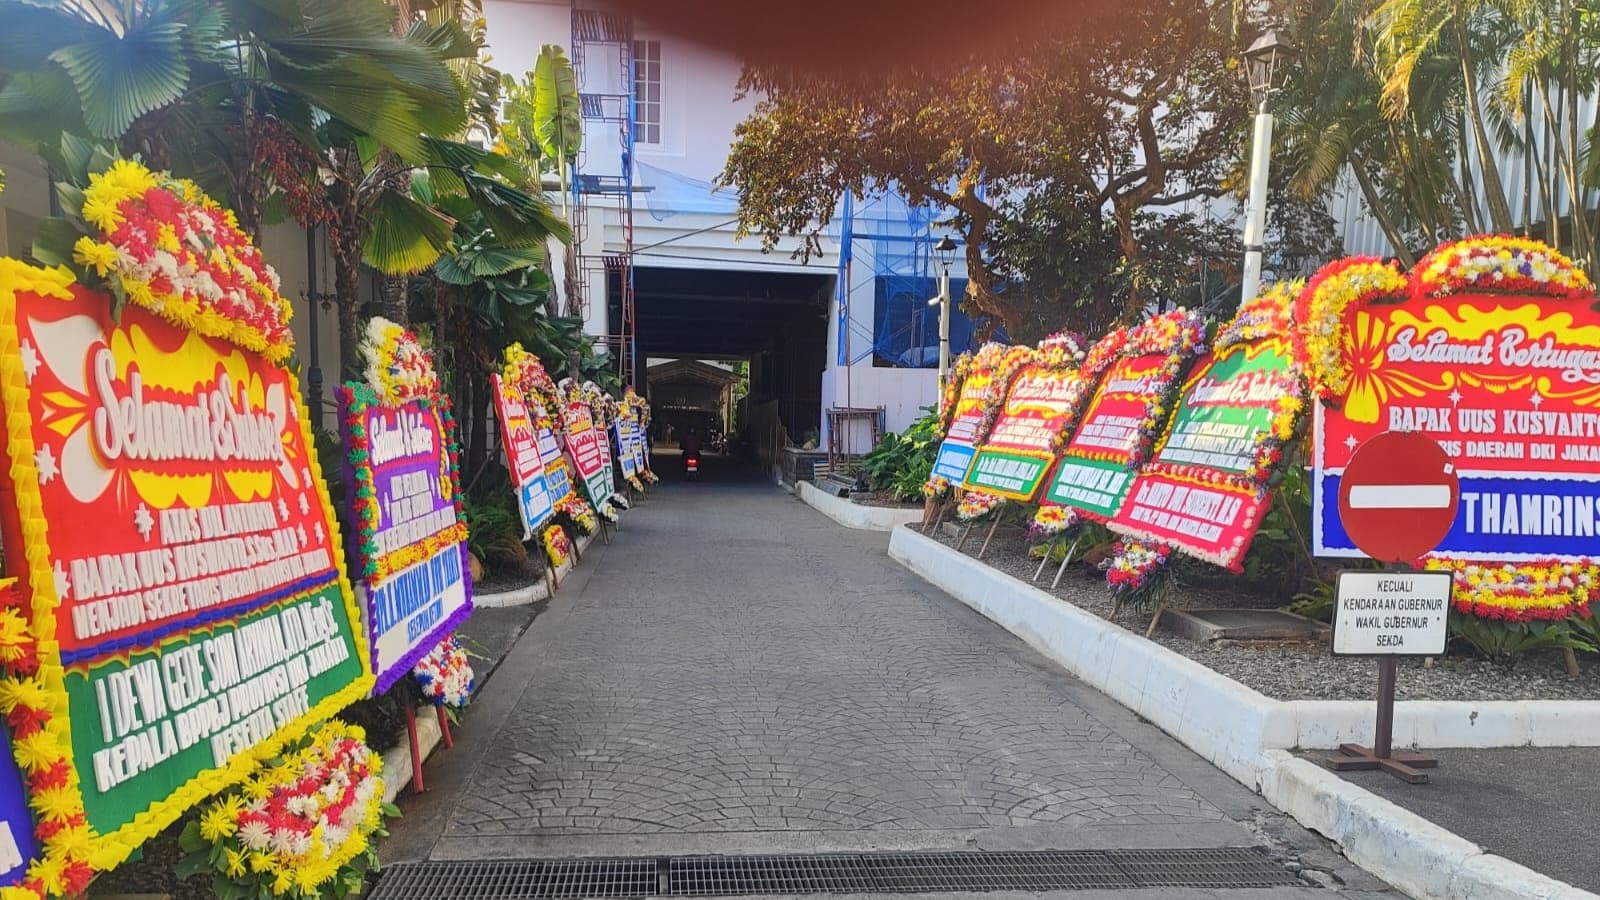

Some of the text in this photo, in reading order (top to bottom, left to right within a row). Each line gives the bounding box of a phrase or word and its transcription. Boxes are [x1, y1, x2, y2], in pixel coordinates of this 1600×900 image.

[1387, 328, 1600, 384] Selamat Bertuga
[95, 348, 213, 461] Selamat
[219, 373, 284, 462] Sukses
[1388, 406, 1600, 437] BAPAK UUS KUSWANT
[1466, 441, 1524, 459] DAERAH
[1530, 443, 1556, 460] DKI
[159, 507, 201, 544] ATAS
[70, 553, 140, 600] BAPAK
[136, 548, 176, 586] UUS
[1377, 580, 1413, 592] KECUALI
[1343, 599, 1443, 611] KENDARAAN GUBERNUR
[1355, 616, 1429, 629] WAKIL GUBERNUR
[1376, 634, 1404, 647] SEKDA
[108, 658, 167, 737] DEWA
[162, 643, 208, 711] GEDE
[93, 719, 179, 793] KEPALA
[174, 693, 231, 750] BPPBJ
